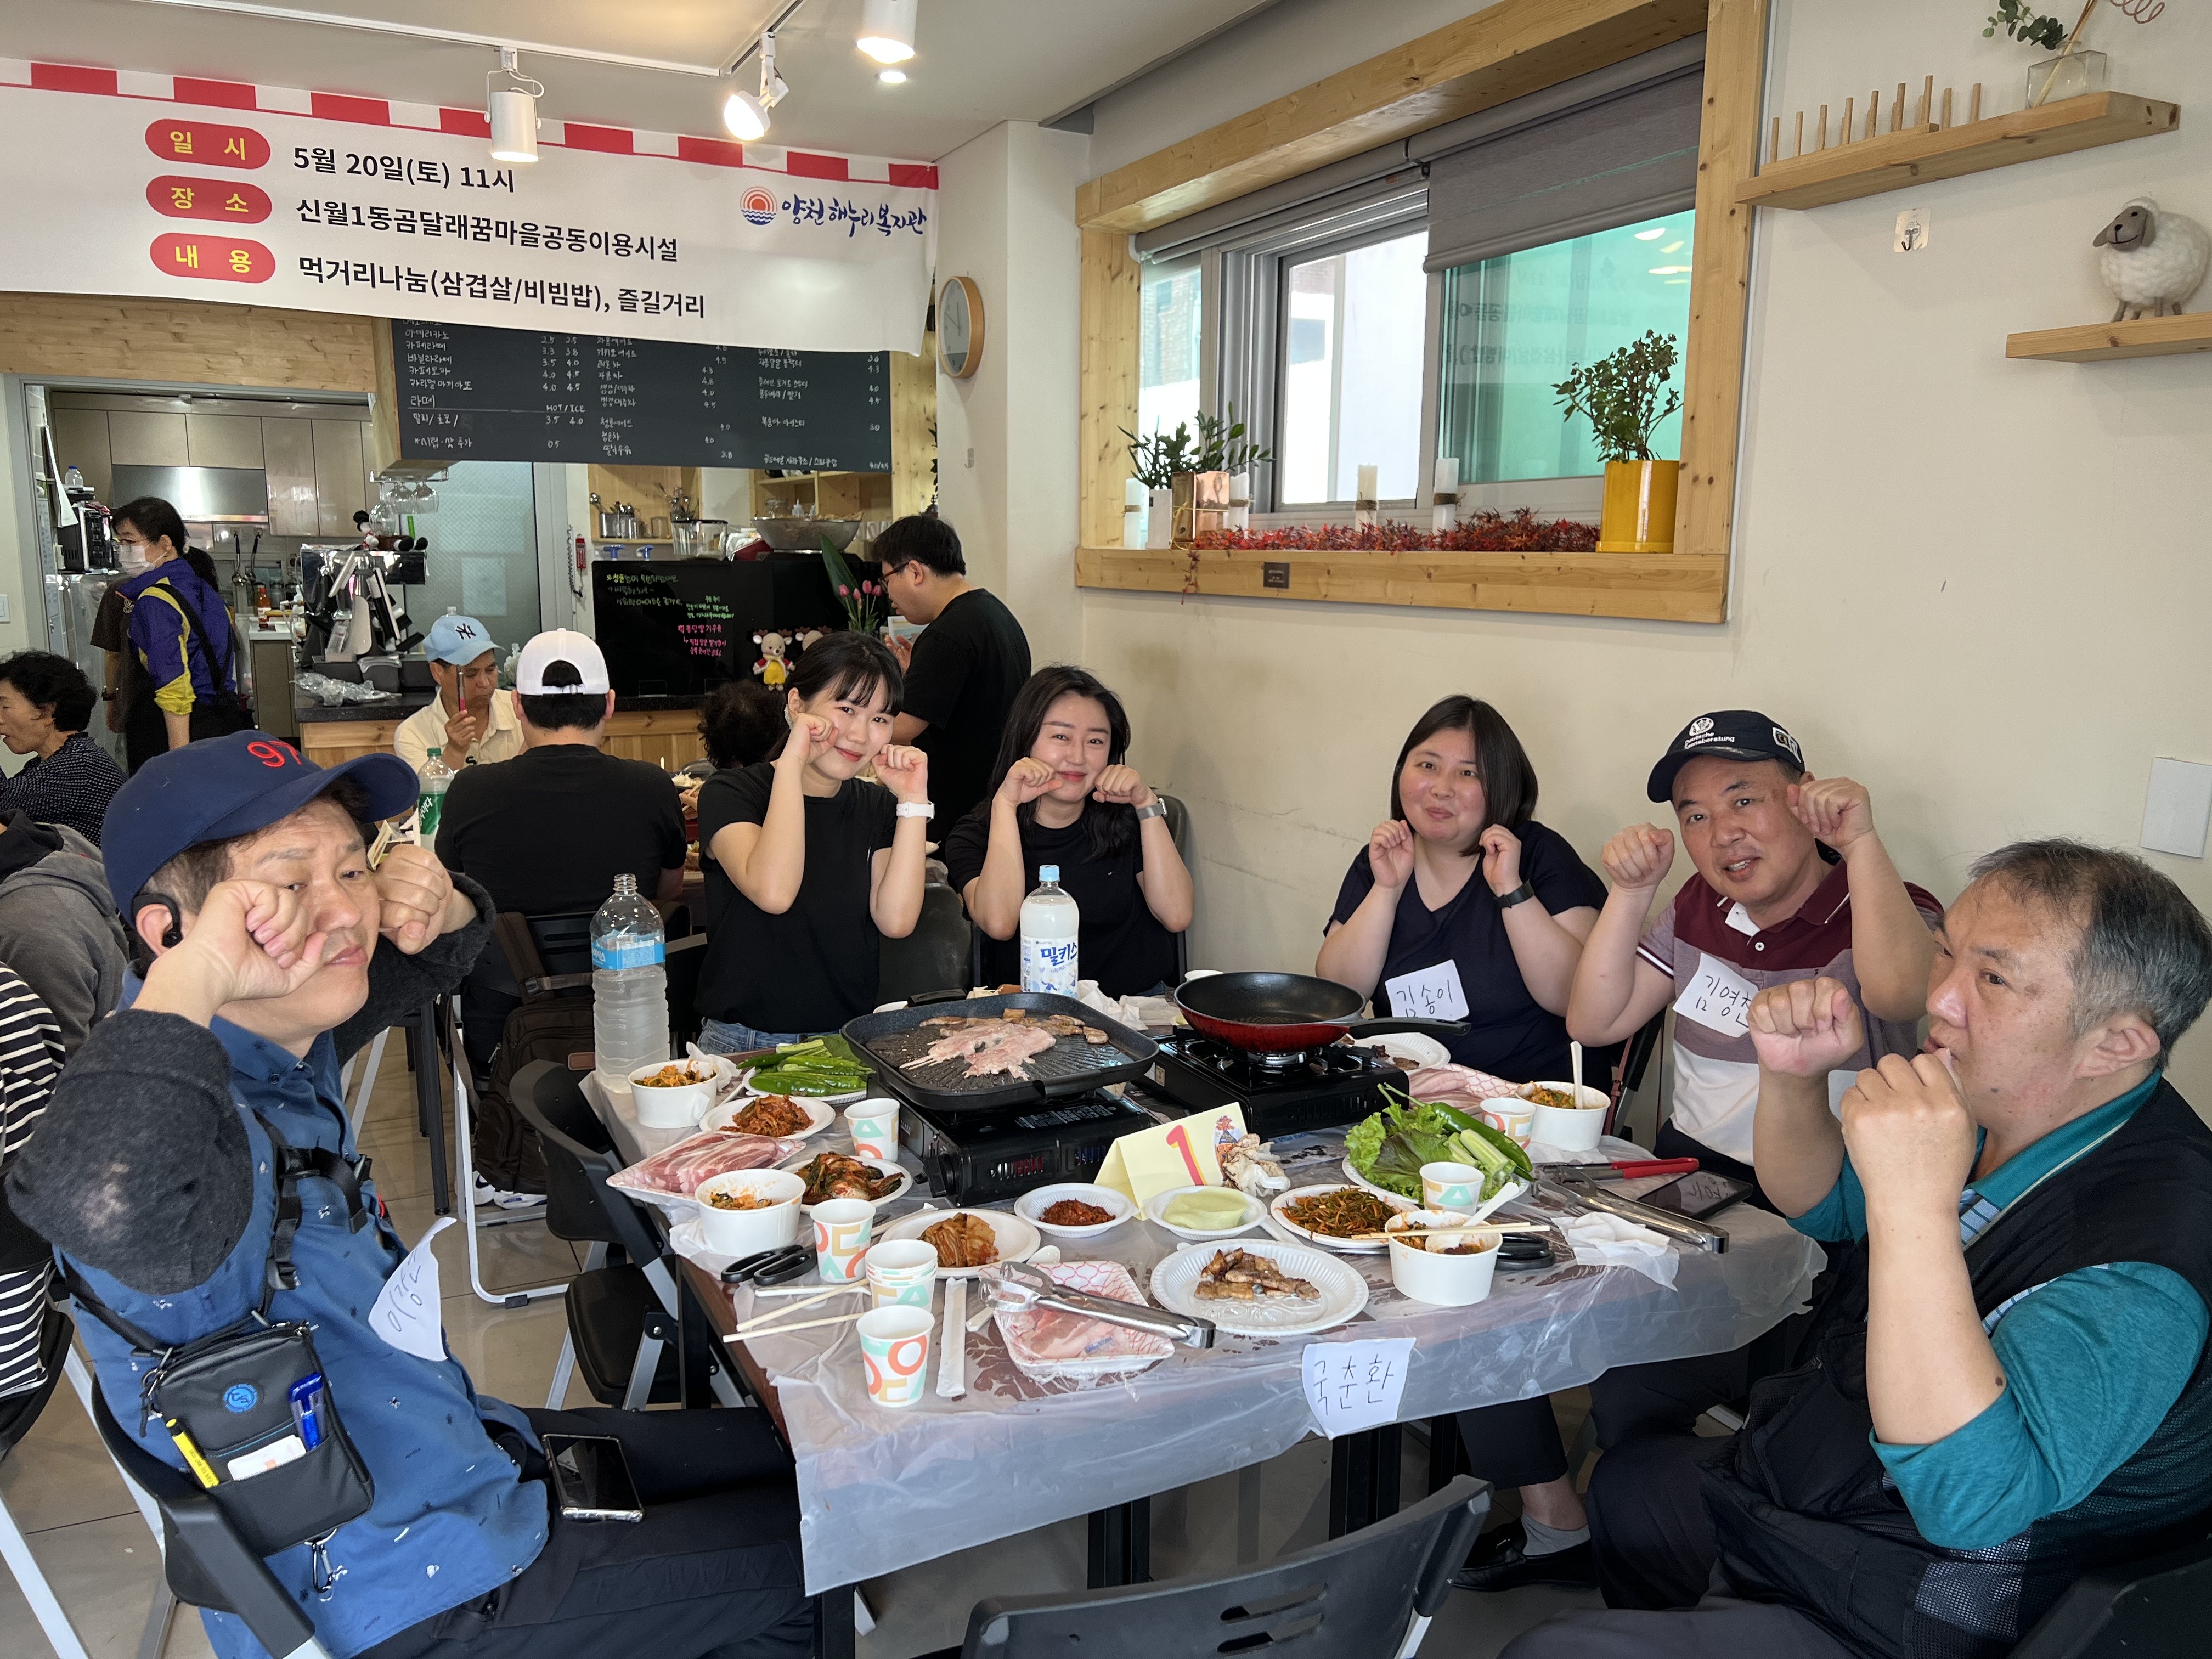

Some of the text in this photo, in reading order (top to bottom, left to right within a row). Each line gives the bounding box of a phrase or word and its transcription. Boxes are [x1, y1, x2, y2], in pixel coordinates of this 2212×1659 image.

[294, 146, 516, 194] 5월 20일(토) 11시
[782, 194, 824, 226] 양천
[296, 199, 678, 263] 신월1동곰달래꿈마을공동이용시설
[298, 256, 705, 319] 먹거리나눔(삼겹살/비빔밥), 즐길거리
[405, 329, 450, 340] 아메리카노
[405, 341, 446, 351] 카페라떼
[542, 358, 579, 368] 3.5 4.0
[409, 366, 451, 376] 카페모카
[542, 370, 580, 380] 4.0 4.5
[543, 382, 580, 392] 4.0 4.5
[410, 394, 436, 408] 라떼
[569, 417, 584, 426] 4.0
[458, 436, 473, 449] 추가
[455, 623, 476, 640] NY
[1040, 941, 1078, 967] 밀키스
[1166, 1124, 1207, 1186] 1
[1313, 1353, 1395, 1415] 국춘환
